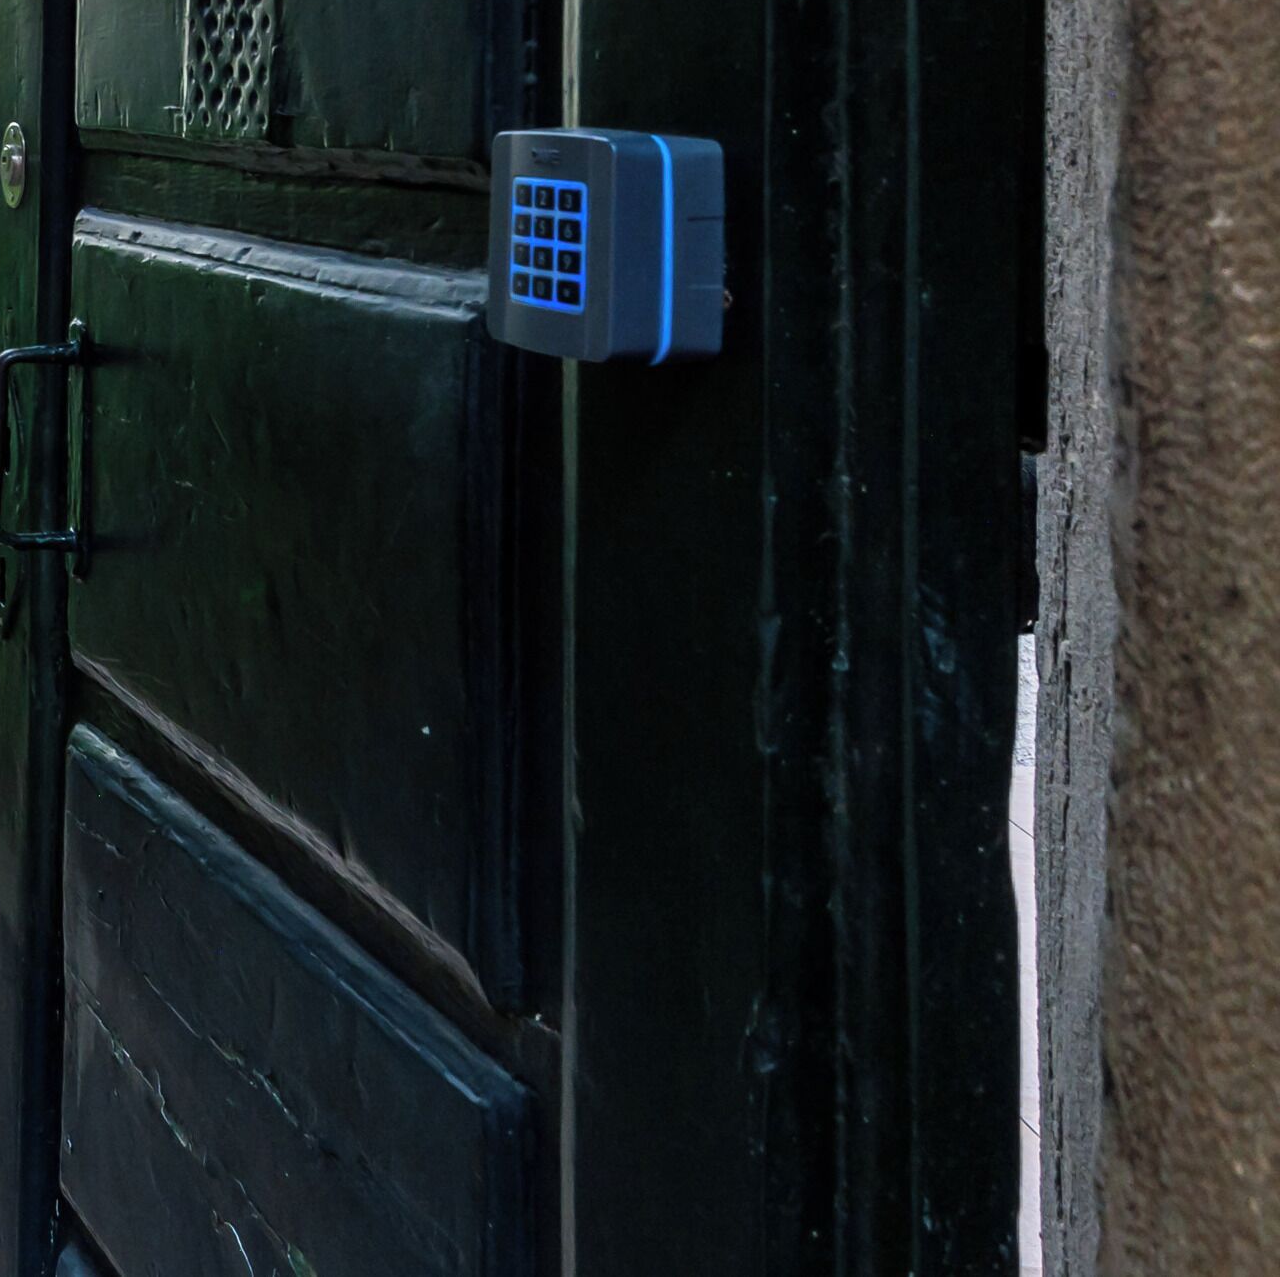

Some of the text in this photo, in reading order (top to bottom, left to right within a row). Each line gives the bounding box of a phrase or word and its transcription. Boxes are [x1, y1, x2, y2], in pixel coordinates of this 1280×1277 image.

[539, 189, 547, 206] 2
[564, 193, 573, 209] 3
[539, 219, 547, 236] 5
[563, 223, 573, 239] 6
[563, 253, 572, 270] 9
